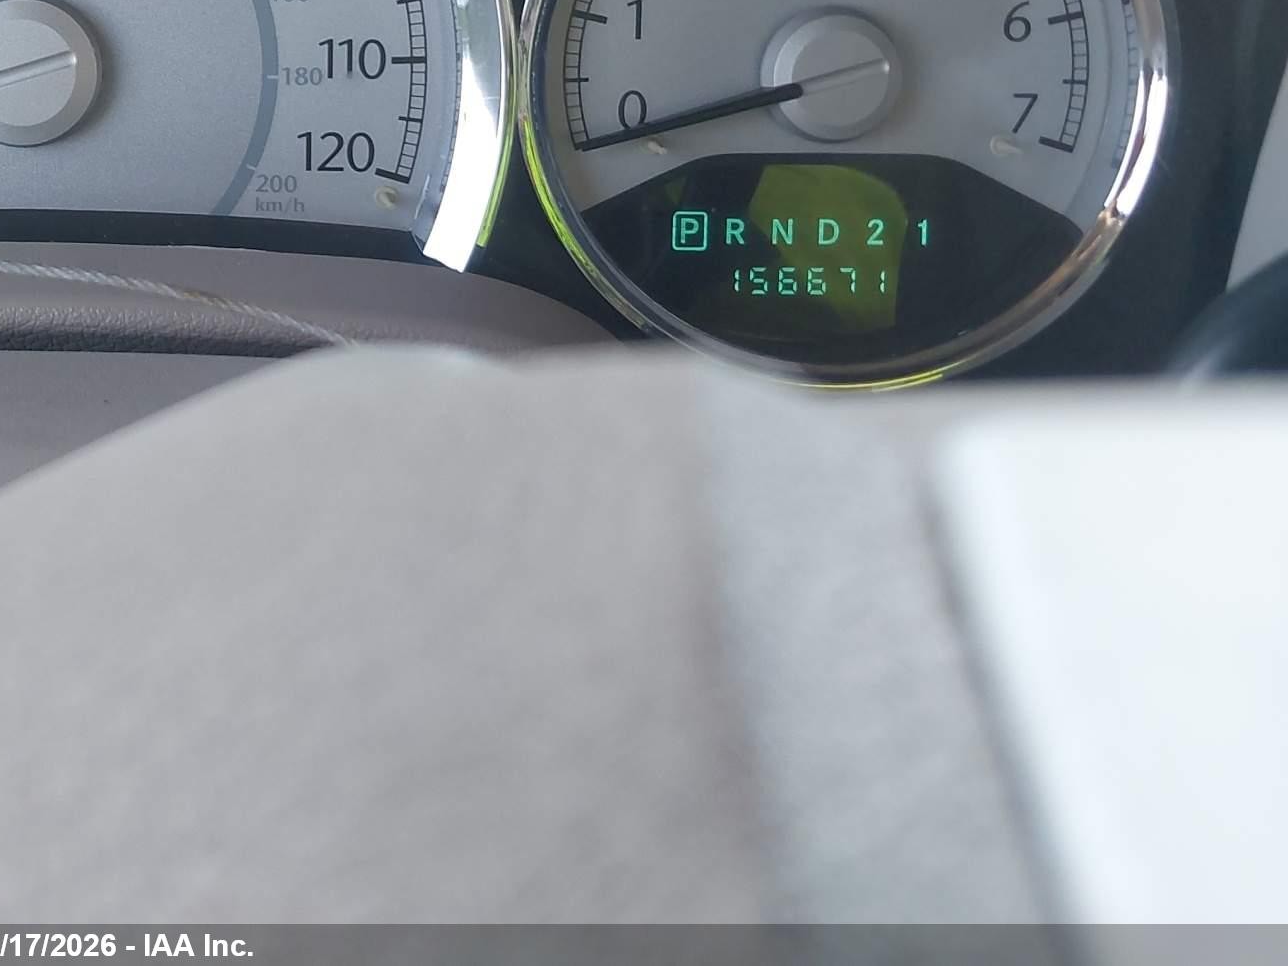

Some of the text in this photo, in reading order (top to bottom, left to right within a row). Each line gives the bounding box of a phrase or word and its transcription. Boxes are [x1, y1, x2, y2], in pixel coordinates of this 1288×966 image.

[627, 0, 642, 39] 1
[1004, 1, 1031, 42] 6
[282, 67, 323, 85] 180
[319, 39, 386, 79] 110
[619, 90, 647, 128] 0
[1012, 94, 1038, 134] 7
[297, 132, 375, 173] 120
[256, 175, 297, 193] 200
[256, 196, 305, 214] km/h
[681, 218, 927, 245] P R N D 2 1
[735, 268, 885, 295] 156671
